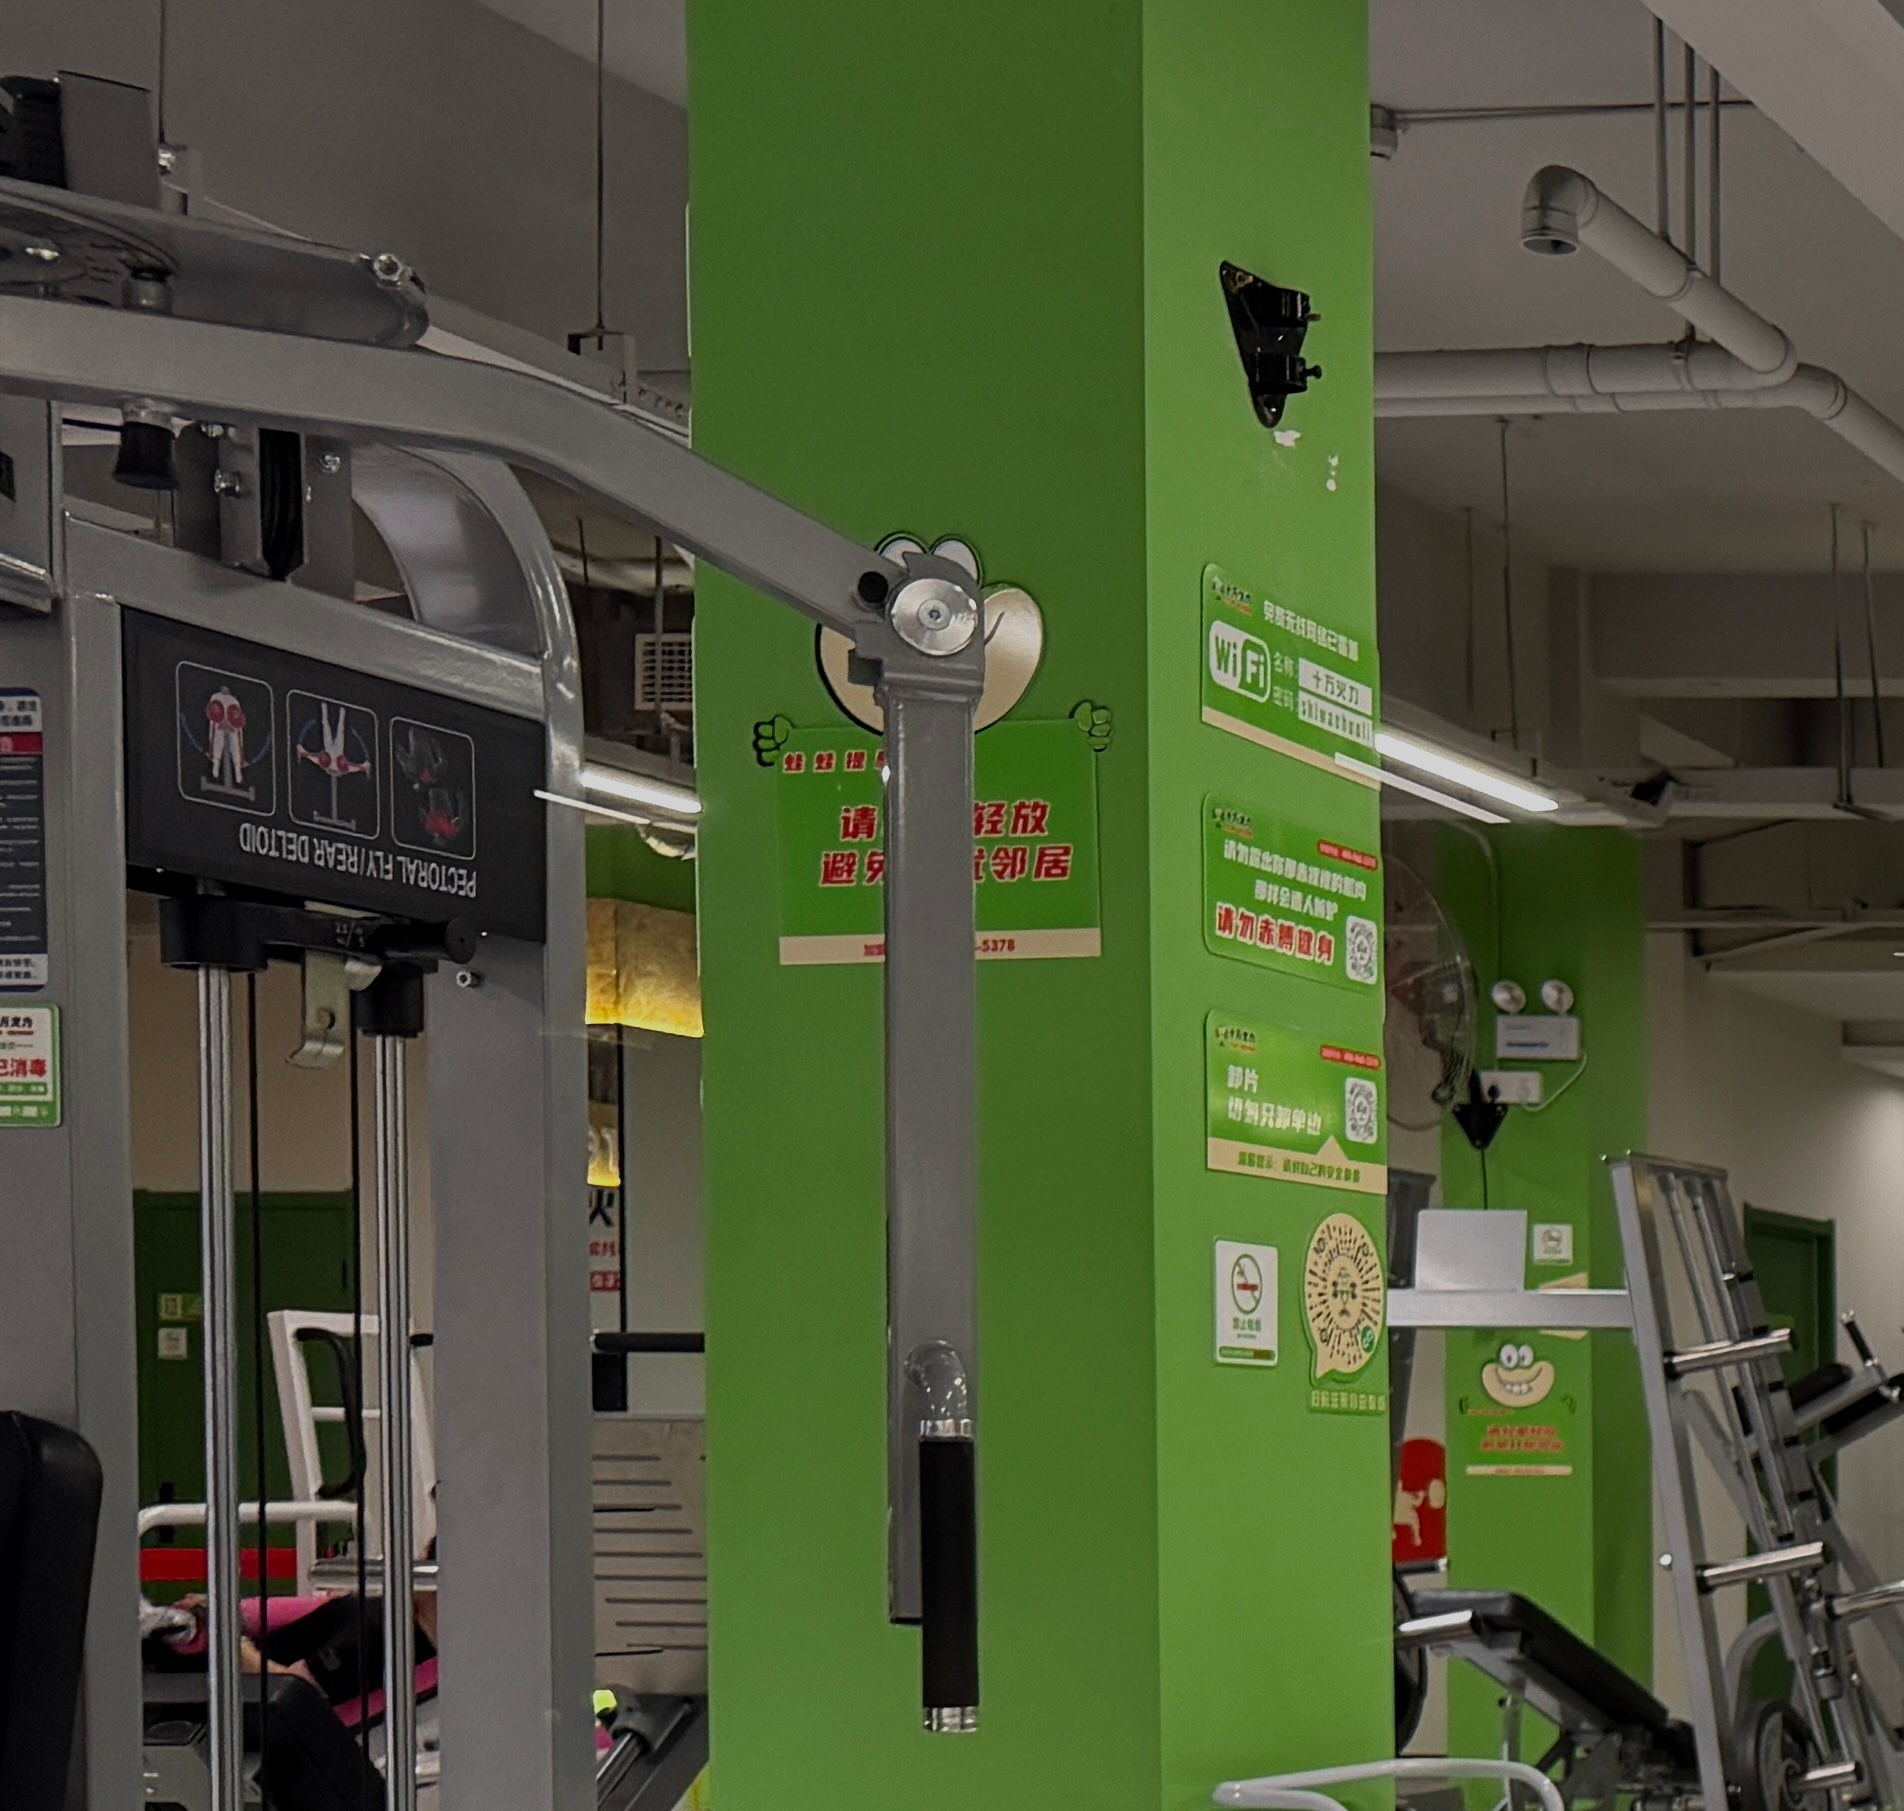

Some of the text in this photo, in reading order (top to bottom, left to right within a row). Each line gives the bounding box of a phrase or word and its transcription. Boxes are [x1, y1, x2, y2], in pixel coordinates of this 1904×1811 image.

[1215, 634, 1265, 689] WiFi
[840, 799, 1050, 842] 请轻放
[239, 822, 477, 898] PECTORAL FLY/REAR DELTOID
